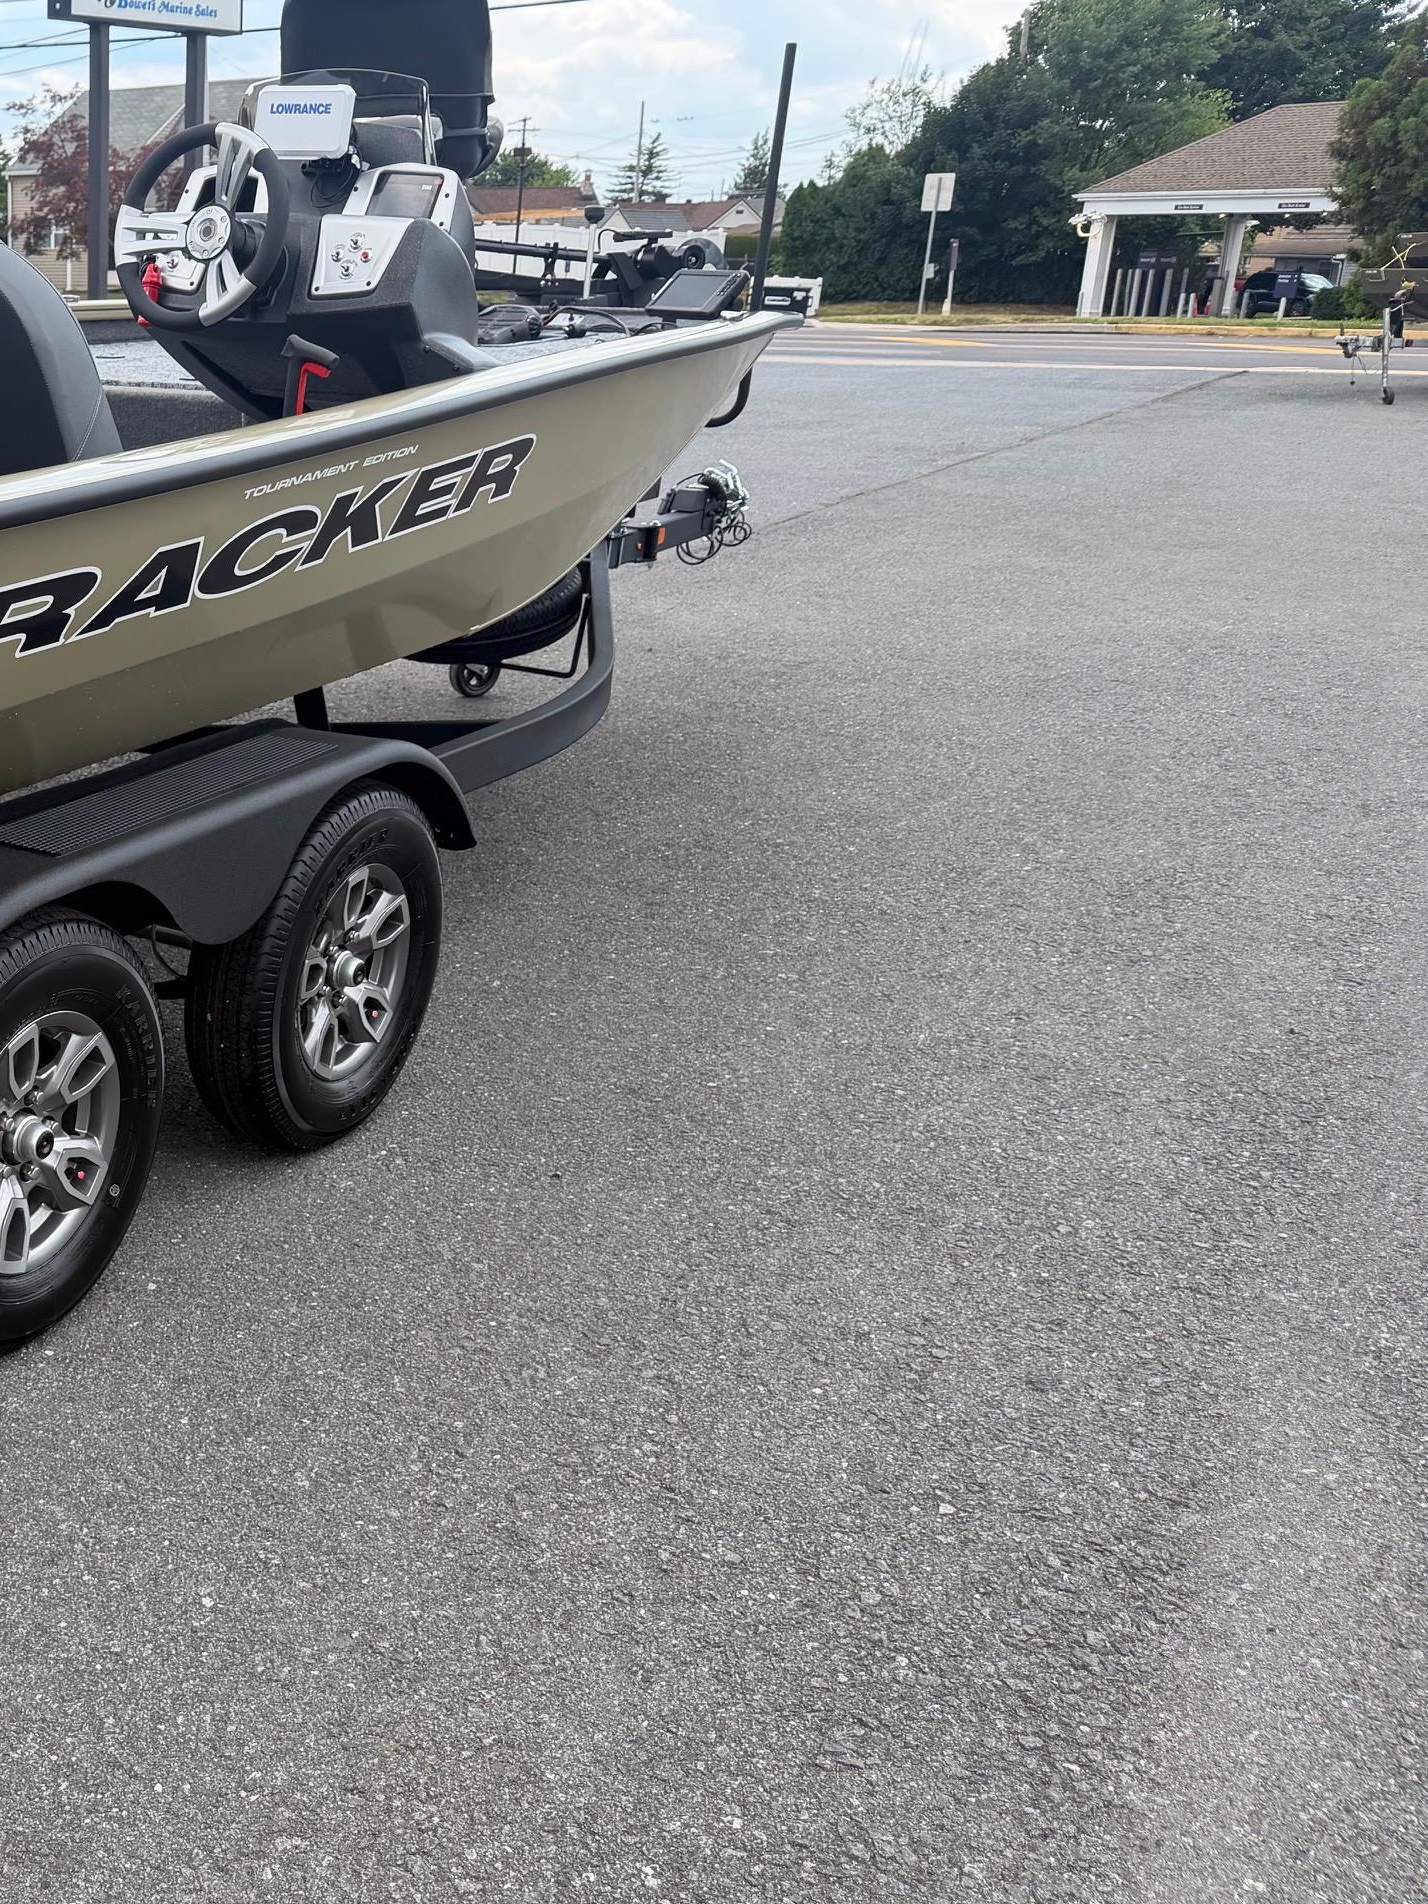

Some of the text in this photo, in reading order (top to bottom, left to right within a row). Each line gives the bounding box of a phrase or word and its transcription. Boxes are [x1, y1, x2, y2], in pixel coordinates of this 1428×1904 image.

[158, 2, 193, 15] Marine
[195, 4, 218, 18] Sales
[270, 103, 332, 115] LOWRANCE
[244, 444, 420, 500] TOURNAMENT EDITION
